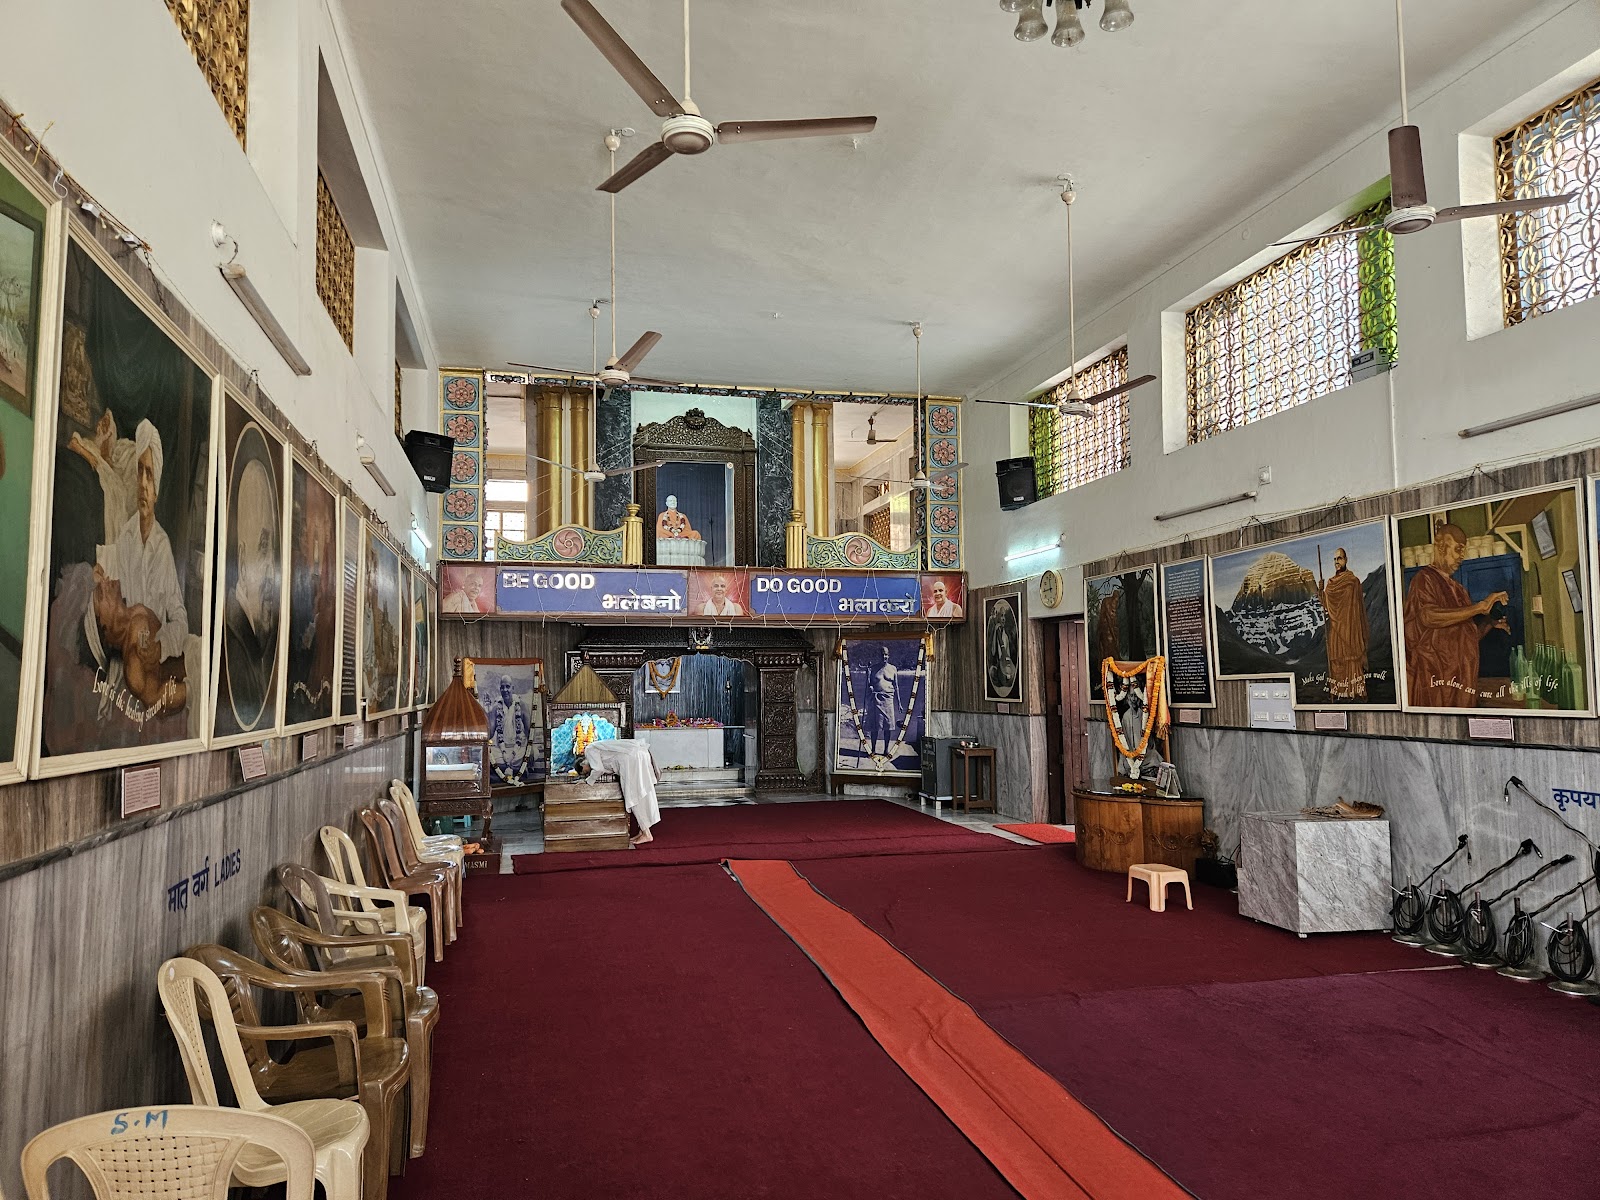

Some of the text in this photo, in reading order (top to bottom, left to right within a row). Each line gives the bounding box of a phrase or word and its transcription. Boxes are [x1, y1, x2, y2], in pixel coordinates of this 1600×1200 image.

[503, 573, 595, 590] BE GOOD
[757, 577, 842, 594] DO GOOD
[1301, 672, 1314, 686] Make
[1315, 671, 1326, 685] God
[1373, 669, 1387, 681] walk
[1430, 674, 1559, 699] Love alone can cure all the ills of life
[92, 666, 109, 696] Love
[109, 682, 116, 702] is
[115, 688, 127, 712] the
[124, 694, 144, 732] healing
[192, 855, 210, 897] वर्ग
[214, 848, 241, 888] LADIES
